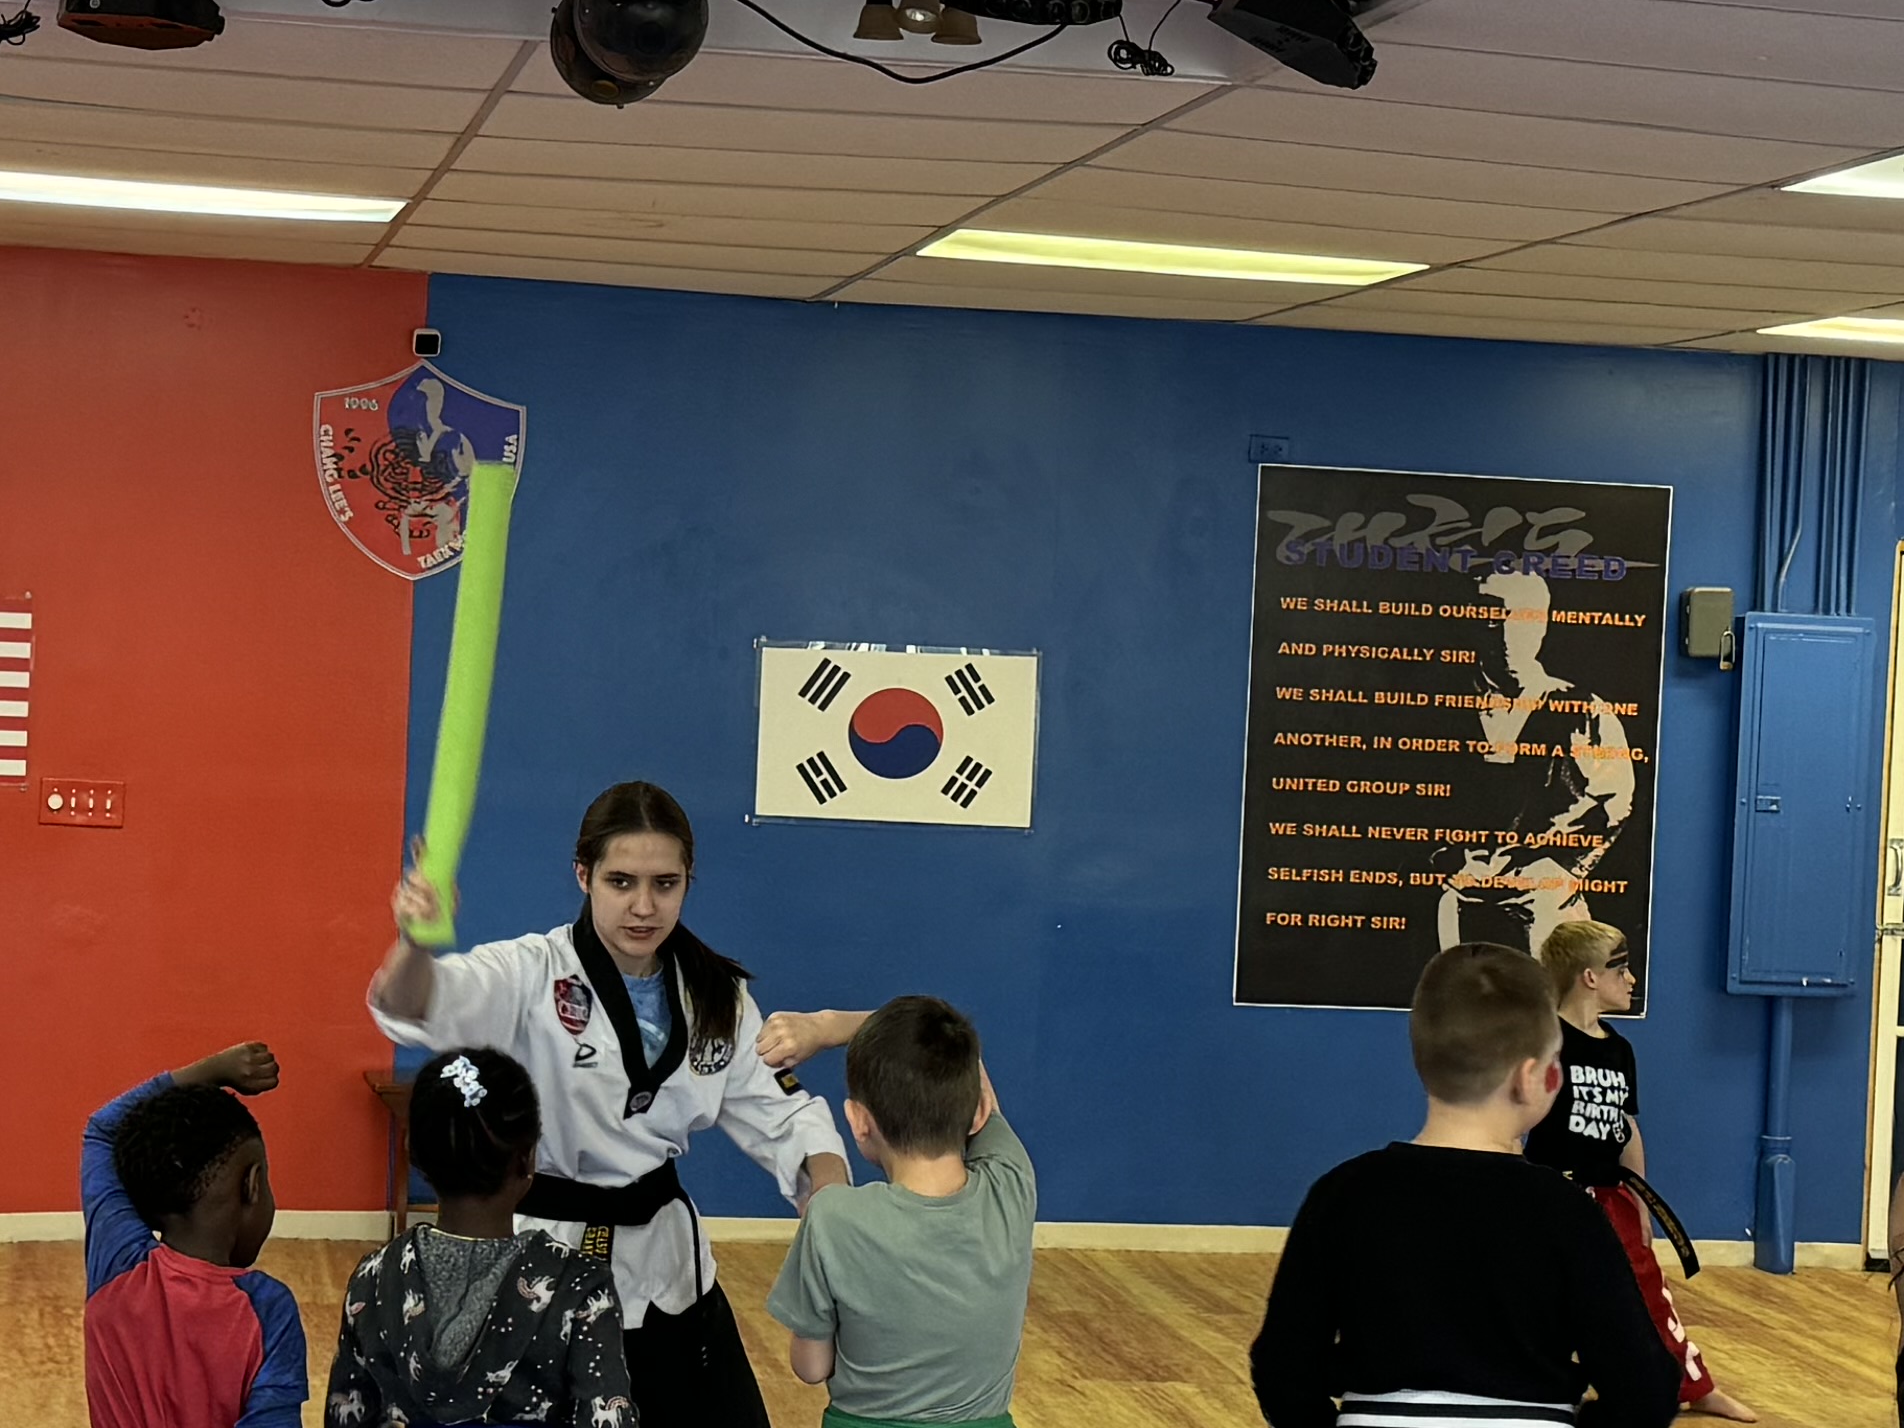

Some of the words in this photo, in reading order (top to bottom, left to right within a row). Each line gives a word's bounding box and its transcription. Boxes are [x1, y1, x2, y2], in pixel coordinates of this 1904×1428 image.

[502, 434, 517, 463] USA
[1285, 538, 1477, 573] STUDENT
[1493, 549, 1627, 581] CREED
[1280, 597, 1308, 610] WE
[1314, 598, 1373, 613] SHALL
[1379, 601, 1433, 616] BUILD
[1552, 610, 1646, 627] MENTALLY
[1278, 642, 1316, 656] AND
[1322, 644, 1434, 661] PHYSICALLY
[1440, 649, 1475, 663] SIR!
[1276, 687, 1304, 700] WE
[1309, 688, 1368, 703] SHALL
[1374, 691, 1429, 706] BUILD
[1549, 699, 1594, 714] WITH
[1598, 702, 1638, 716] ONE
[1273, 732, 1367, 750] ANOTHER,
[1373, 736, 1392, 749] IN
[1398, 737, 1460, 752] ORDER
[1466, 740, 1489, 754] TO
[1551, 745, 1564, 757] A
[1272, 777, 1340, 792] UNITED
[1346, 780, 1410, 794] GROUP
[1415, 783, 1451, 797] SIR!
[1269, 822, 1297, 835] WE
[1302, 823, 1362, 838] SHALL
[1368, 826, 1429, 841] NEVER
[1434, 829, 1490, 843] FIGHT
[1494, 831, 1518, 844] TO
[1524, 833, 1604, 848] ACHIEVE
[1268, 867, 1343, 882] SELFISH
[1350, 870, 1403, 887] ENDS,
[1409, 873, 1446, 886] BUT
[1568, 879, 1628, 893] MIGHT
[1266, 912, 1302, 926] FOR
[1308, 914, 1365, 928] RIGHT
[1370, 916, 1406, 930] SIR!
[1573, 1085, 1603, 1103] IT'S
[1605, 1089, 1629, 1106] MY
[1568, 1115, 1611, 1140] DAY
